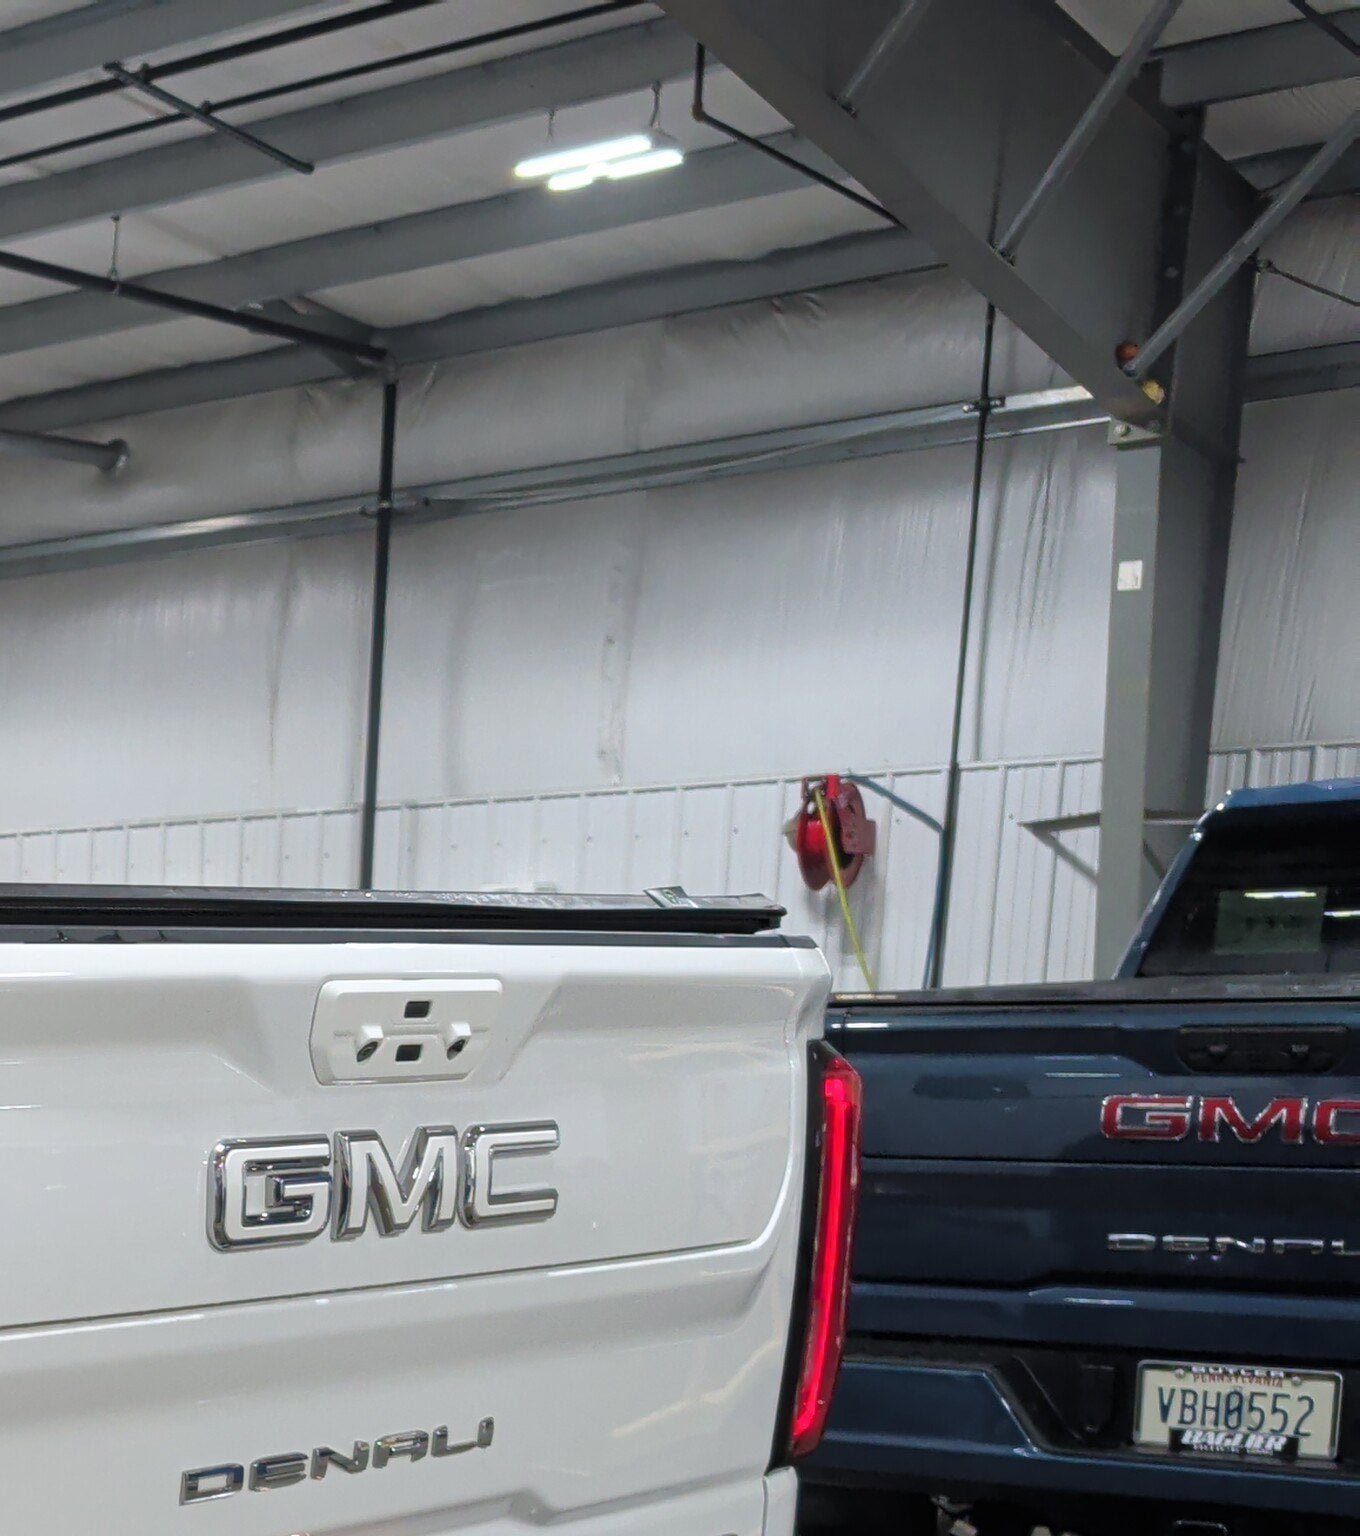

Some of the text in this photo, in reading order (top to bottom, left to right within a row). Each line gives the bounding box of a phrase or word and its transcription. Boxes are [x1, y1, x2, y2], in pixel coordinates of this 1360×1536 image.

[1101, 1093, 1360, 1145] GMC
[206, 1119, 559, 1253] GMC
[1157, 1386, 1314, 1437] VBH0552
[179, 1415, 495, 1506] DENALI
